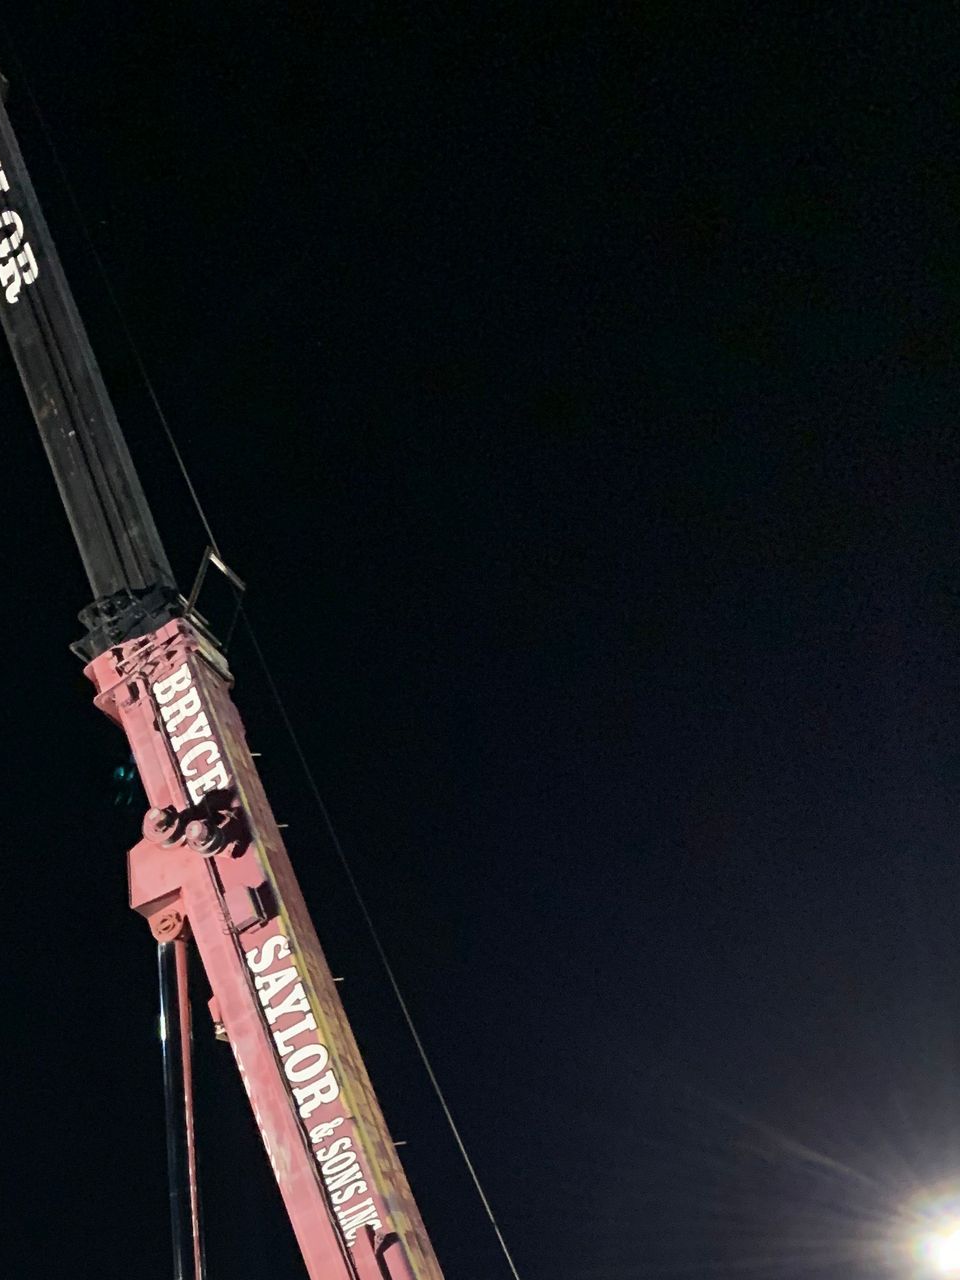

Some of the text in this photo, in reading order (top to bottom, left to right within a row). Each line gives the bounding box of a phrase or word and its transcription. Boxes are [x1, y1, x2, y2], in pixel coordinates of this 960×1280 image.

[152, 662, 230, 806] BRYCE
[245, 935, 340, 1119] SAYLOR
[309, 1116, 344, 1143] &
